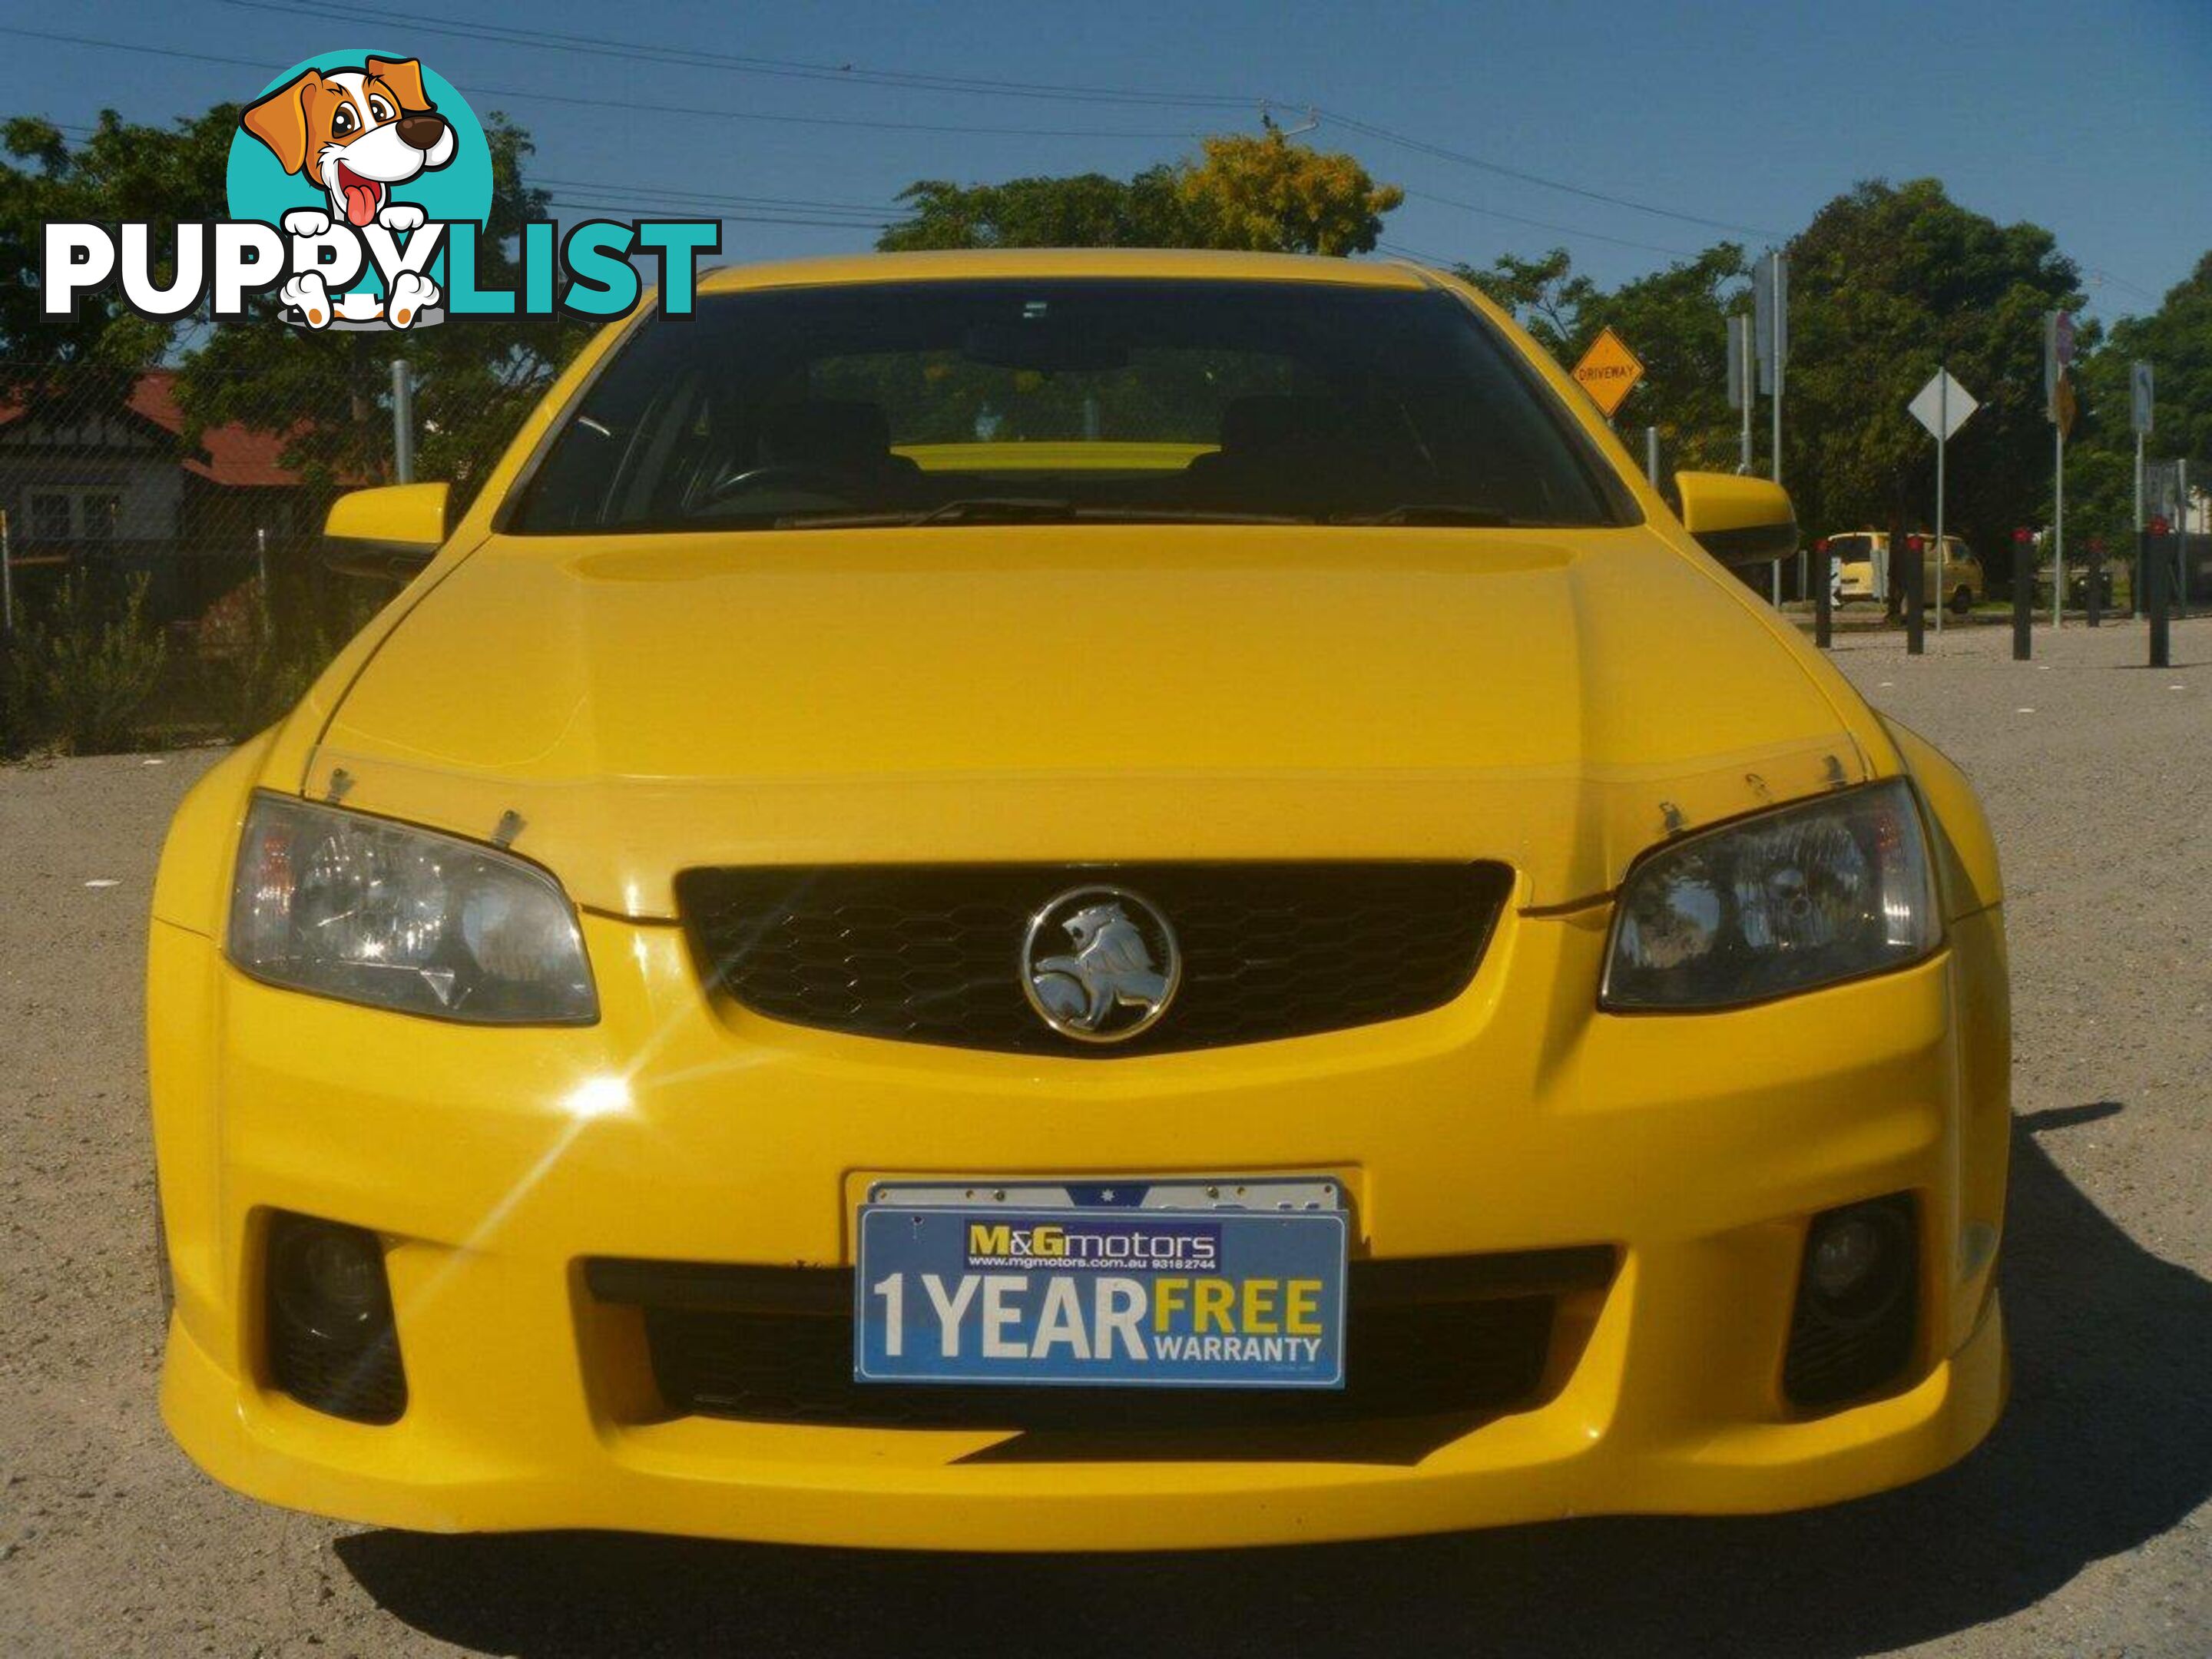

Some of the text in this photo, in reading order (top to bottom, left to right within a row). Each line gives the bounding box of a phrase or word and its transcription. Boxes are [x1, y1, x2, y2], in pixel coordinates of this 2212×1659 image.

[1579, 365, 1634, 381] DRIVEWAY
[969, 1256, 1147, 1269] www.mgmotors.com.au
[874, 1273, 1323, 1359] 1 YEAR FREE
[1154, 1336, 1322, 1361] WARRANTY
